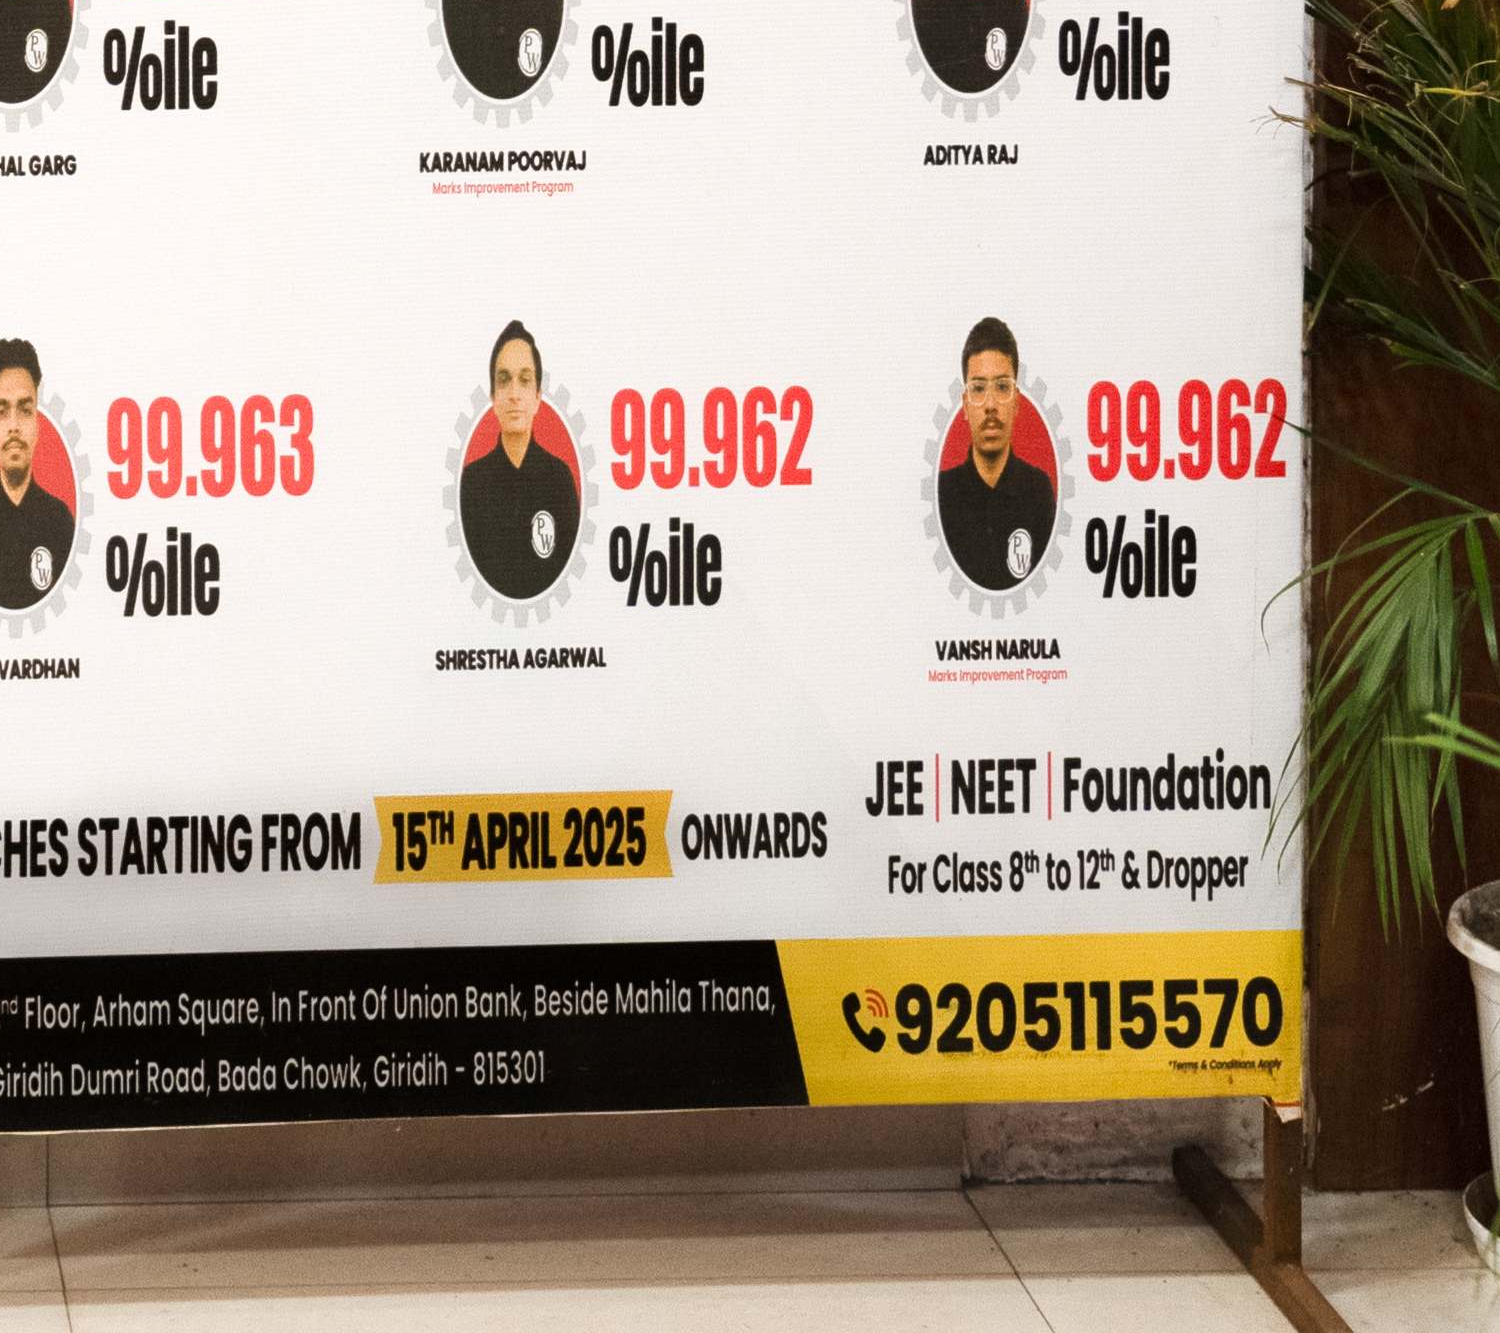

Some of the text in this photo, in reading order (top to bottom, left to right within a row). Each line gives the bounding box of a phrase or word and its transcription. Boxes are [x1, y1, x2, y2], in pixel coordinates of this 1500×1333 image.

[102, 19, 219, 112] %ile
[27, 154, 78, 177] GARG
[419, 149, 587, 174] KARANAM POORVAJ
[923, 143, 1019, 167] ADITYA RAJ
[106, 393, 315, 500] 99.963
[610, 385, 814, 491] 99.962
[1087, 378, 1288, 482] 99.962
[1084, 508, 1198, 600] %ile
[435, 646, 608, 672] SHRESTHA AGARWAL
[927, 667, 1069, 685] Marks Improvement Program
[934, 638, 1061, 662] VANSH NARULA
[864, 747, 1272, 818] JEE NEET Foundation
[77, 813, 254, 878] STARTING
[260, 811, 362, 873] FROM
[461, 811, 558, 871] APRIL
[563, 806, 647, 868] 2025
[680, 810, 828, 861] ONWARDS
[887, 847, 1250, 903] For Class 8th to 12th Dropper
[24, 977, 776, 1037] Floor, Arham Square, In Front Of Union Bank, Beside Mahila Thana,
[894, 976, 1284, 1055] 9205115570
[70, 1058, 140, 1097] Dumri
[146, 1058, 211, 1097] Road,
[218, 1057, 277, 1093] Bada
[283, 1054, 367, 1091] Chowk,
[373, 1051, 448, 1088] Giridih
[473, 1049, 545, 1086] 815301
